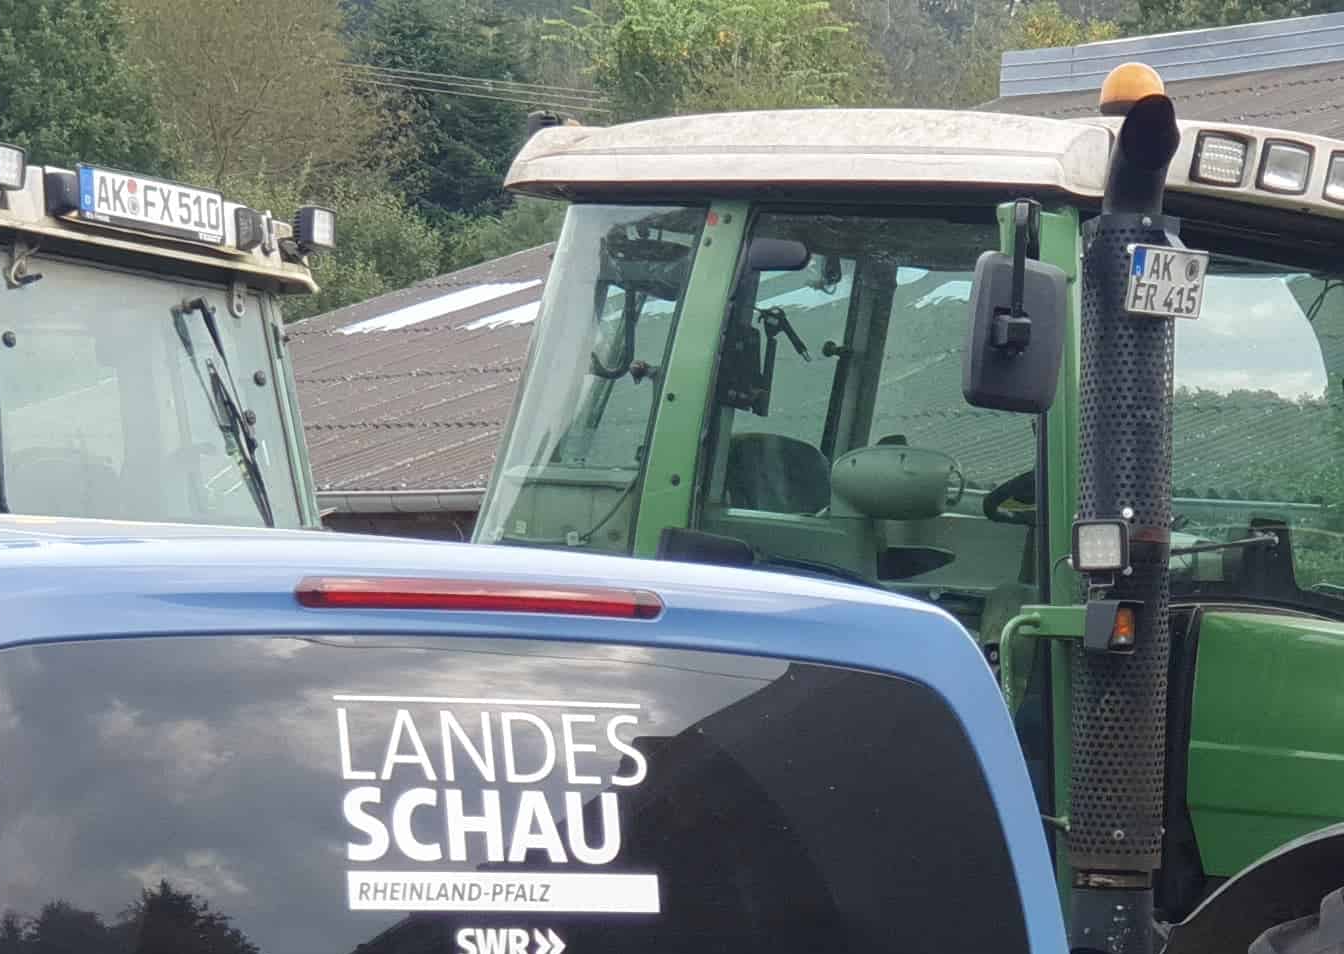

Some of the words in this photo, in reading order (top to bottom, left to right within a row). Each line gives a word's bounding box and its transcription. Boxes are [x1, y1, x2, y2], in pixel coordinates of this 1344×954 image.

[98, 176, 127, 213] AK
[143, 185, 173, 222] FX
[178, 191, 221, 230] 510
[1150, 253, 1176, 281] AK
[1131, 283, 1158, 311] FR
[1163, 284, 1200, 314] 415
[336, 708, 648, 786] LANDES
[343, 786, 622, 865] SCHAU
[358, 881, 551, 903] RHEINLAND-PFALZ
